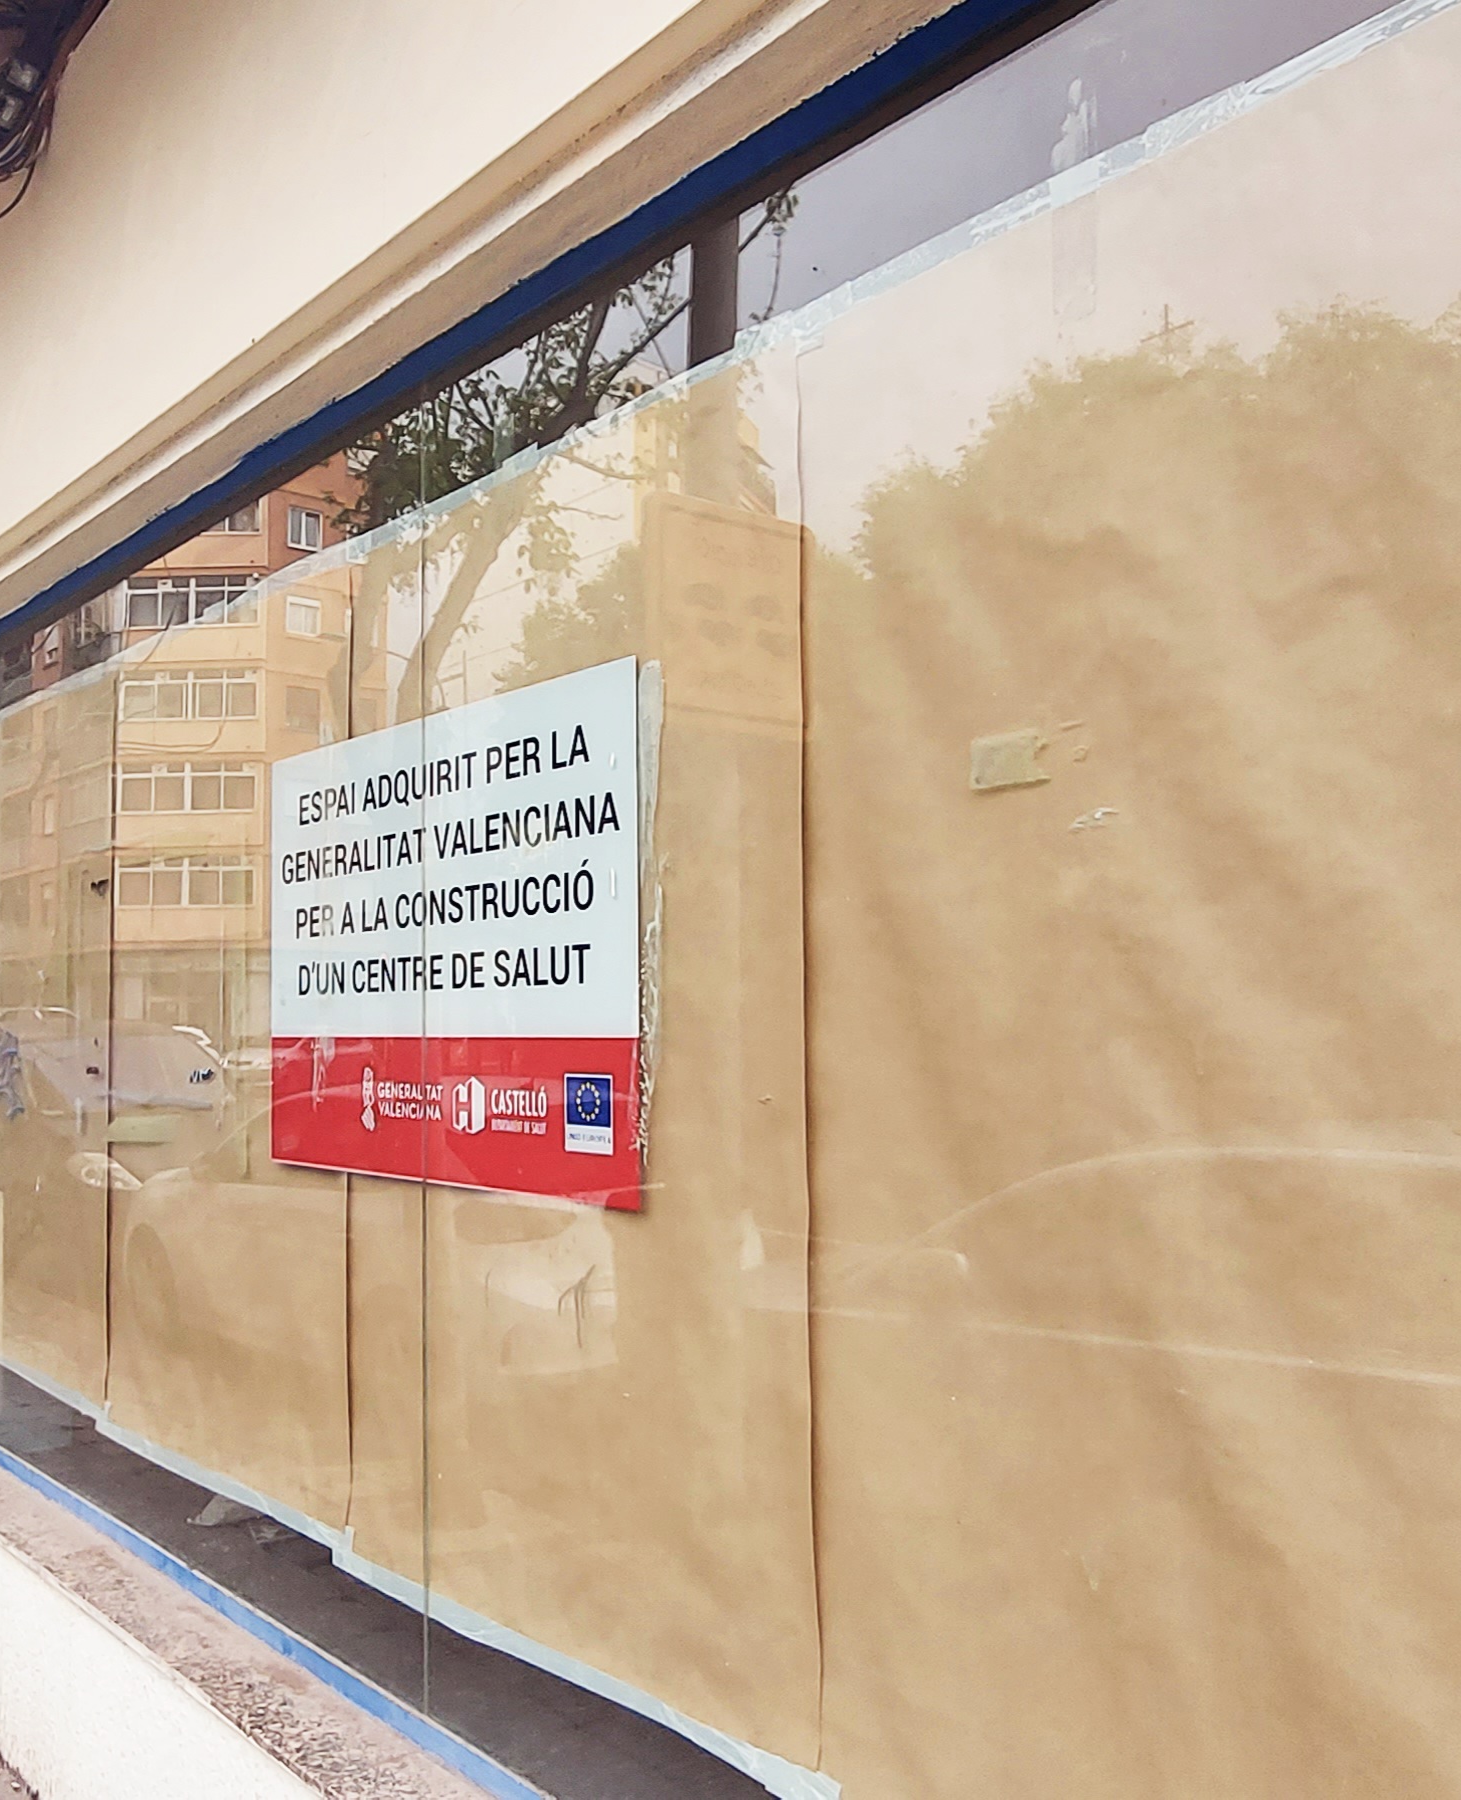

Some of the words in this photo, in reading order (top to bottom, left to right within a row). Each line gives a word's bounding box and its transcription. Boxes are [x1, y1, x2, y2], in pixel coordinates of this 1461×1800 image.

[299, 782, 356, 826] ESPAI
[363, 751, 477, 812] ADQUIRIT
[485, 736, 541, 784] PER
[551, 724, 590, 770] LA
[281, 827, 427, 884] GENERALITAT
[434, 792, 620, 859] VALENCIANA
[296, 904, 334, 939] PER
[340, 911, 355, 934] A
[361, 905, 388, 932] LA
[395, 858, 594, 929] CONSTRUCCIÓ
[298, 961, 345, 995] D'UN
[352, 954, 443, 993] CENTRE
[451, 951, 485, 989] DE
[493, 944, 591, 987] SALUT
[378, 1080, 444, 1101] GENERALTAT
[491, 1086, 548, 1118] CASTELLÓ
